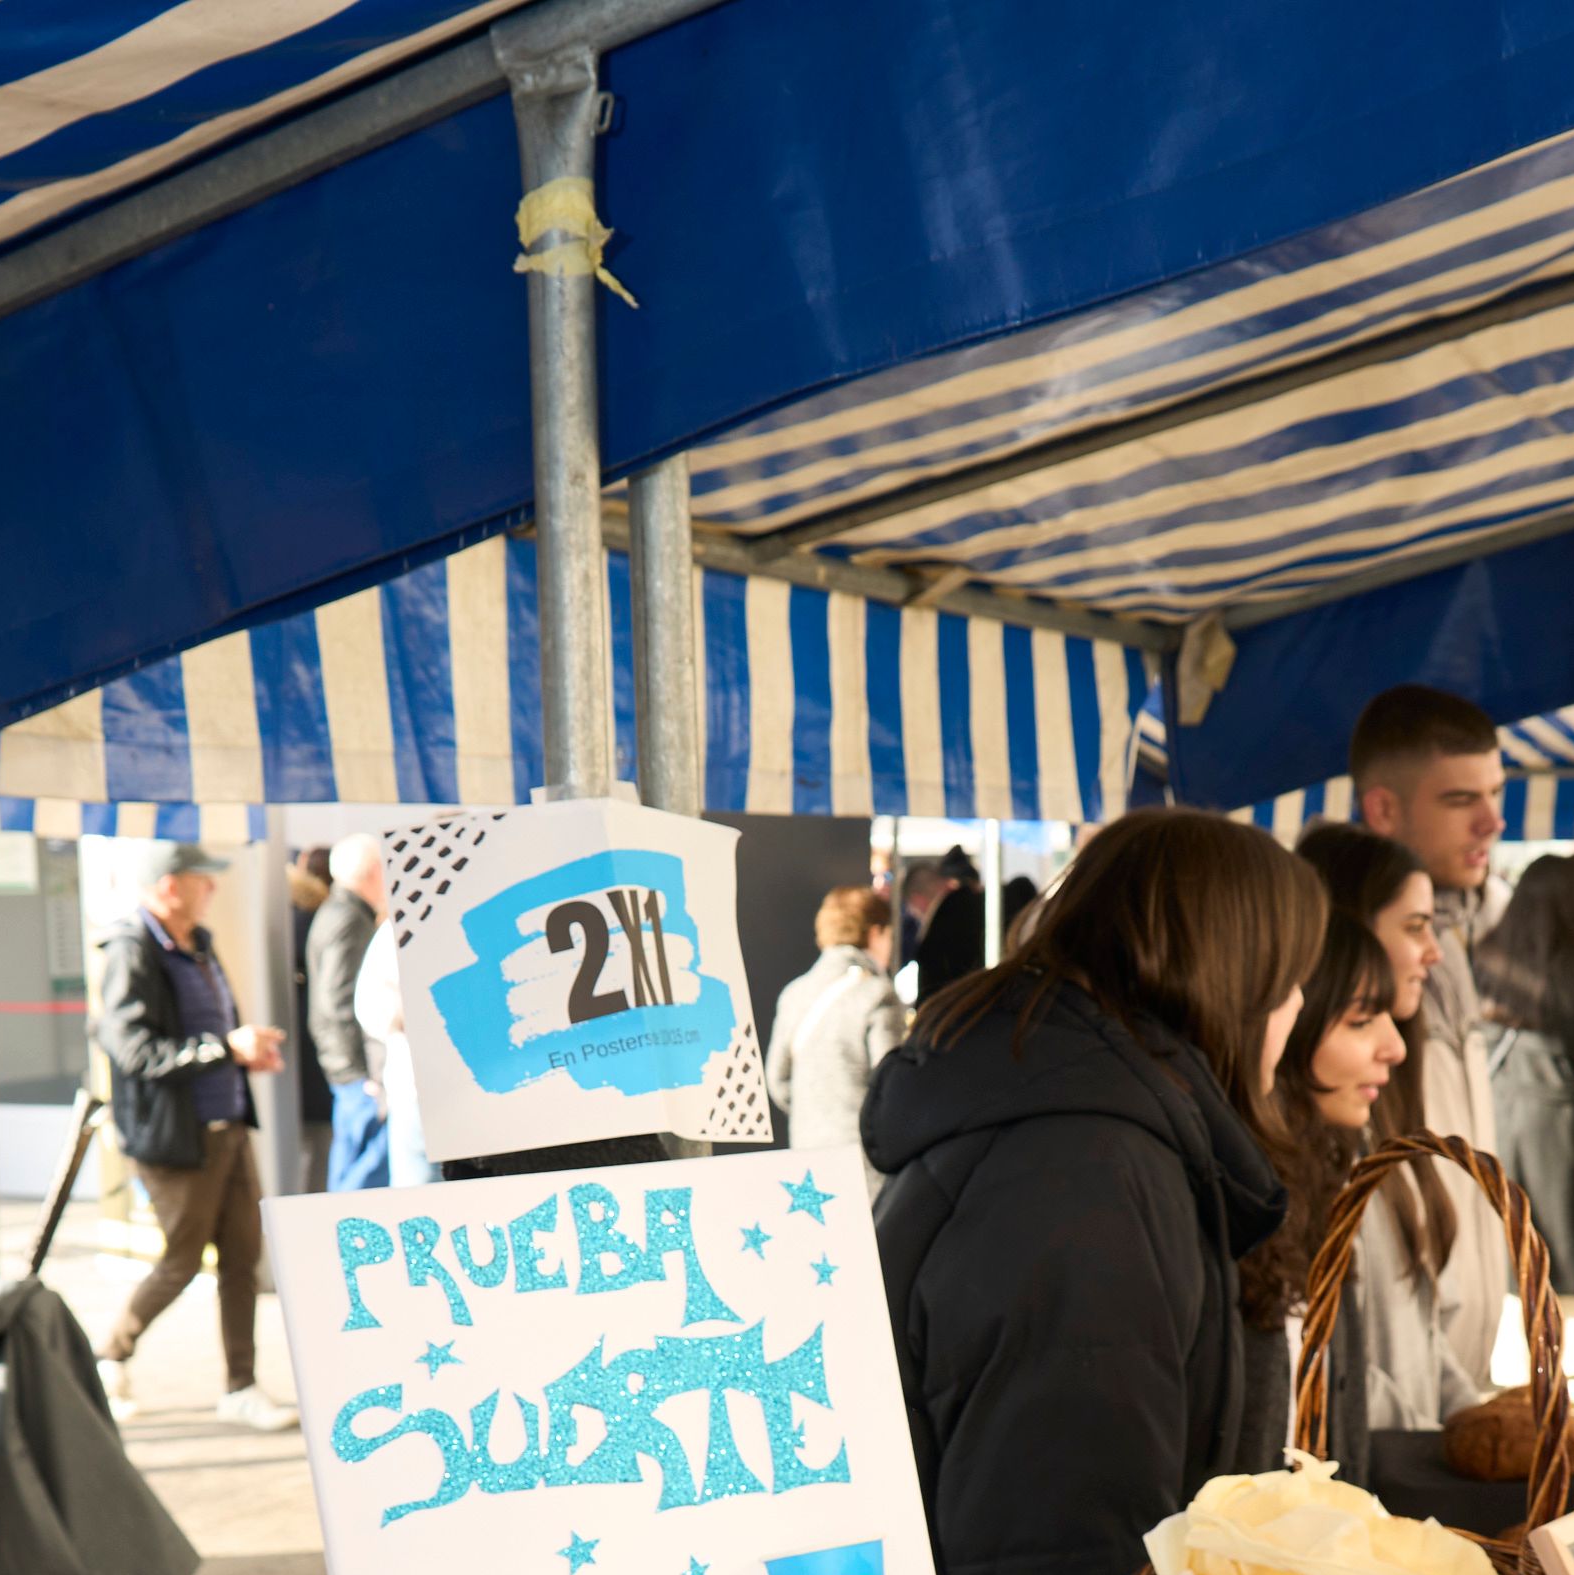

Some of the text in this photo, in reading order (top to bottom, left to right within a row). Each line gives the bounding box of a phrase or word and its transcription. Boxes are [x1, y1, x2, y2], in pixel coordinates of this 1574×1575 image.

[548, 1049, 577, 1069] En
[336, 1183, 745, 1332] PRUEBA
[331, 1318, 852, 1528] SUERTE
